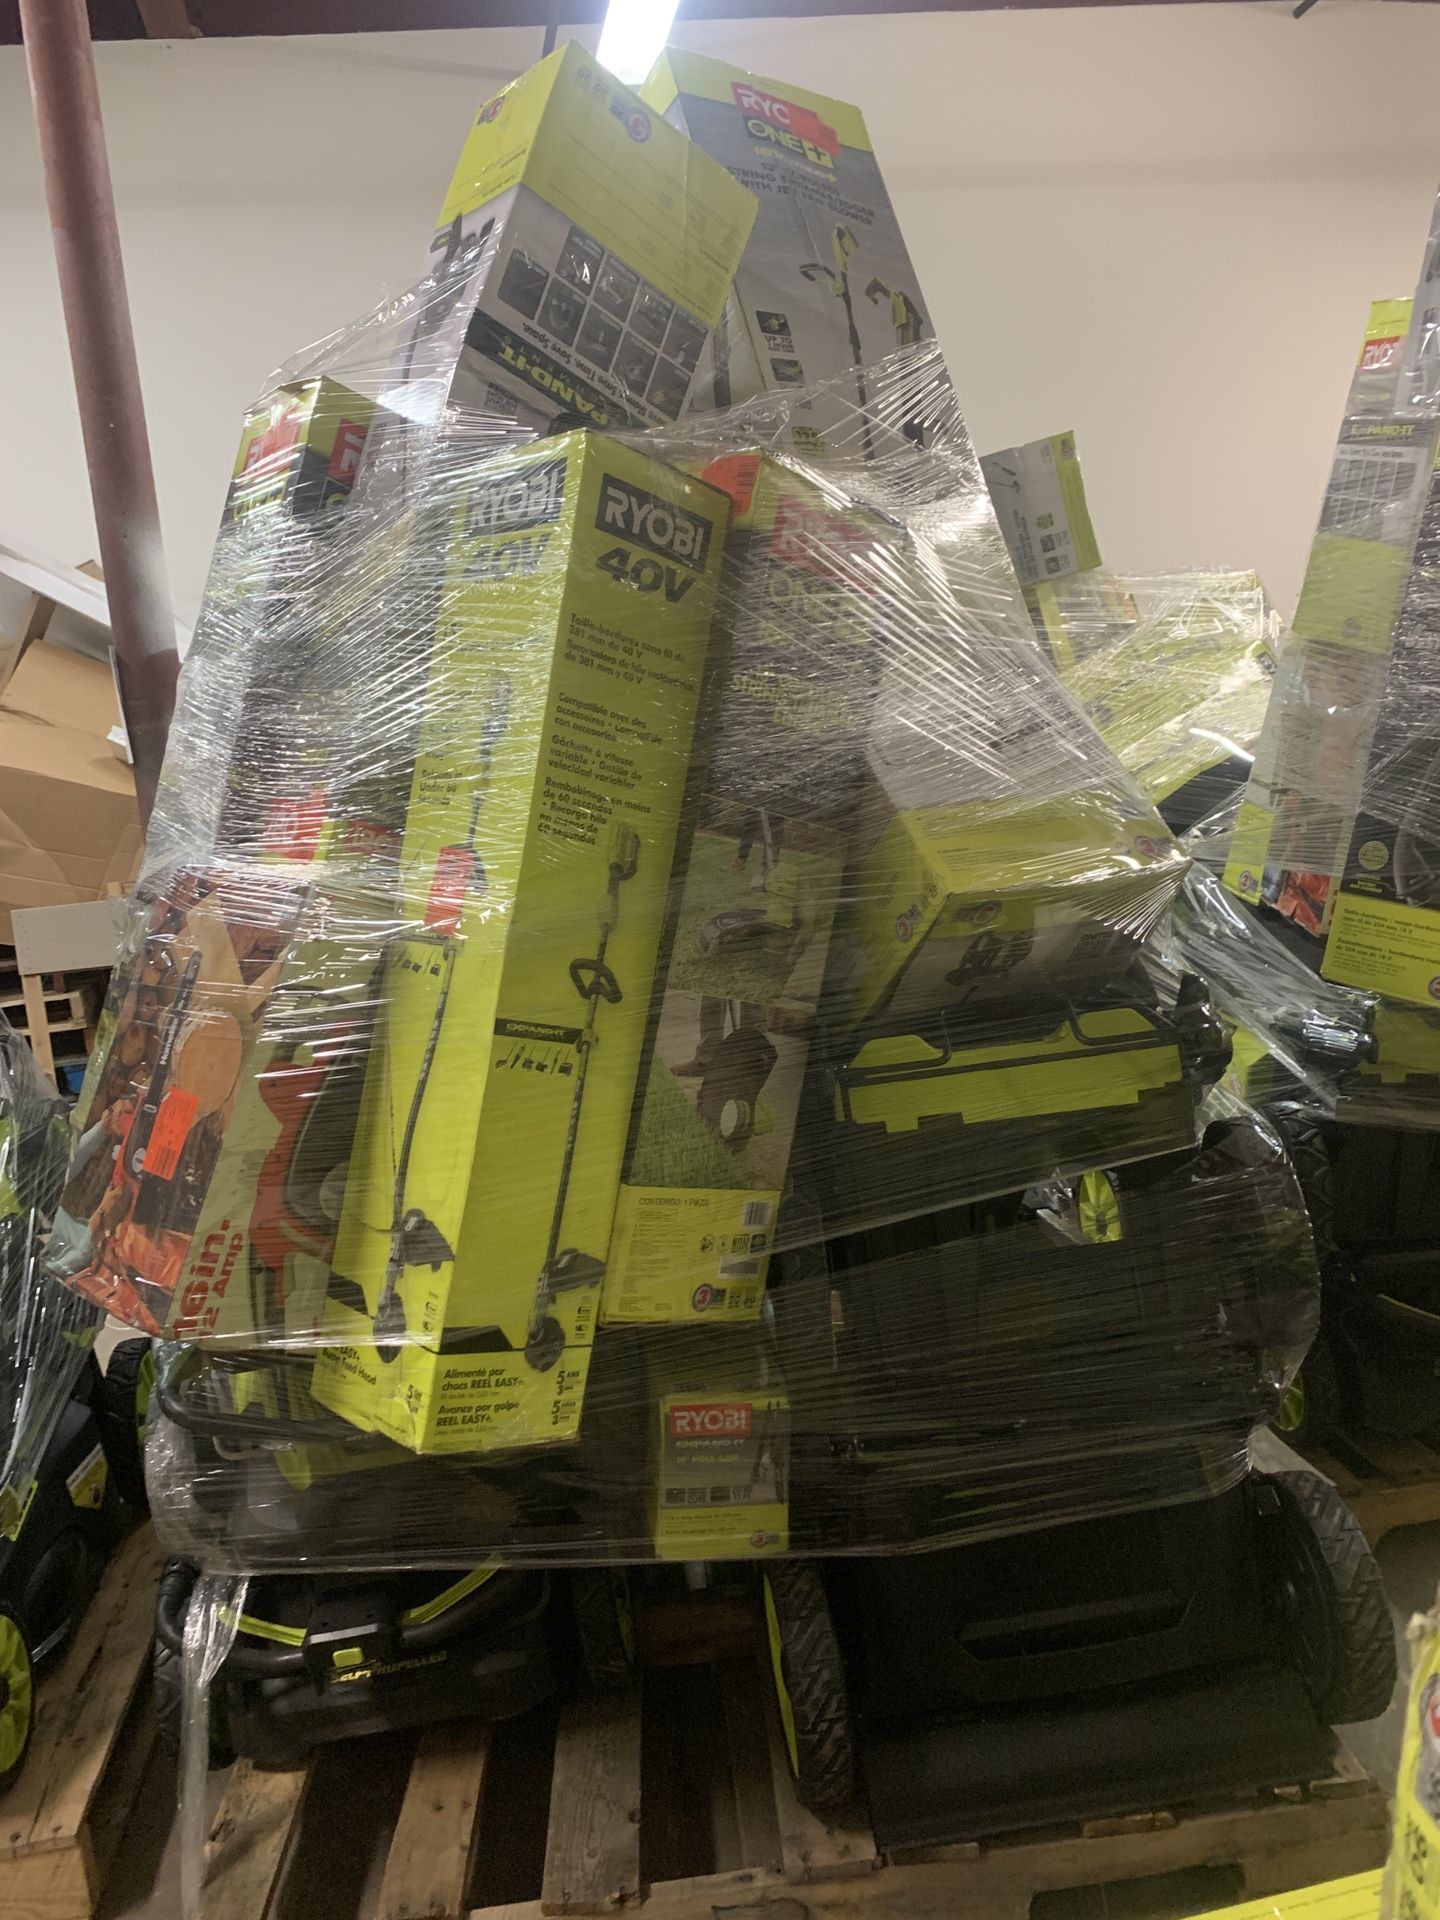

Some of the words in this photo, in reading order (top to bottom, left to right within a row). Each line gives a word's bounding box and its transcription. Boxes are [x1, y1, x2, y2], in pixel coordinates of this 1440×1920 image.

[550, 341, 572, 364] Save
[574, 356, 597, 383] Time.
[605, 486, 705, 560] RYOBI
[595, 547, 697, 604] 40V
[571, 613, 639, 647] Taille-bordures
[569, 625, 585, 641] 381
[588, 634, 606, 647] mm
[622, 645, 634, 657] 40
[636, 649, 644, 660] V
[564, 651, 577, 662] de
[578, 655, 594, 668] 381
[597, 662, 614, 676] mm
[636, 675, 644, 685] V
[556, 705, 606, 728] accessoires
[558, 691, 608, 716] Compatible
[610, 710, 630, 724] avec
[632, 716, 647, 729] des
[554, 716, 571, 728] con
[548, 757, 593, 779] velocidad
[631, 769, 643, 781] de
[543, 788, 556, 800] de
[558, 791, 571, 803] 60
[611, 797, 623, 808] en
[624, 799, 651, 815] moins
[539, 812, 551, 823] en
[587, 821, 599, 834] de
[550, 801, 588, 820] Recarga
[589, 811, 608, 826] hilo
[212, 1231, 244, 1299] Amp
[442, 1379, 468, 1392] chocs
[470, 1378, 493, 1390] REEL
[444, 1367, 487, 1380] Alimenté
[489, 1368, 506, 1381] par
[556, 1370, 566, 1385] 5
[438, 1404, 474, 1416] Avance
[475, 1403, 491, 1415] por
[494, 1400, 520, 1413] golpe
[551, 1400, 562, 1415] 5
[436, 1415, 459, 1428] REEL
[674, 1409, 746, 1433] RYOBI
